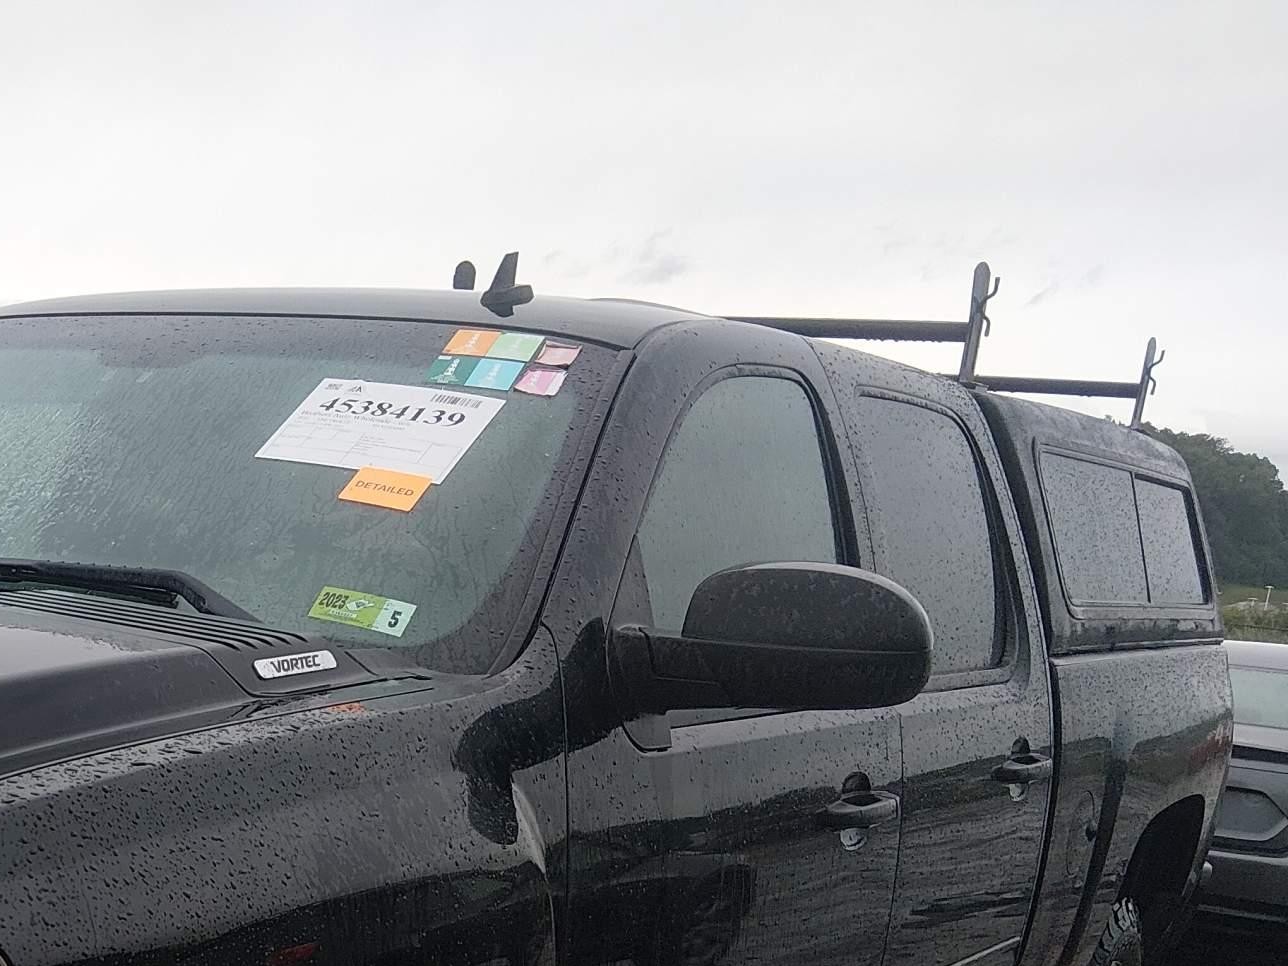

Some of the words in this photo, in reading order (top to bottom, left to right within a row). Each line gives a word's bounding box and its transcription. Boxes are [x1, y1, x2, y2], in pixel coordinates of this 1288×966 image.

[319, 397, 466, 427] 45384139
[355, 480, 414, 496] DETAILED
[387, 610, 402, 628] 5
[270, 654, 320, 673] VORTEC
